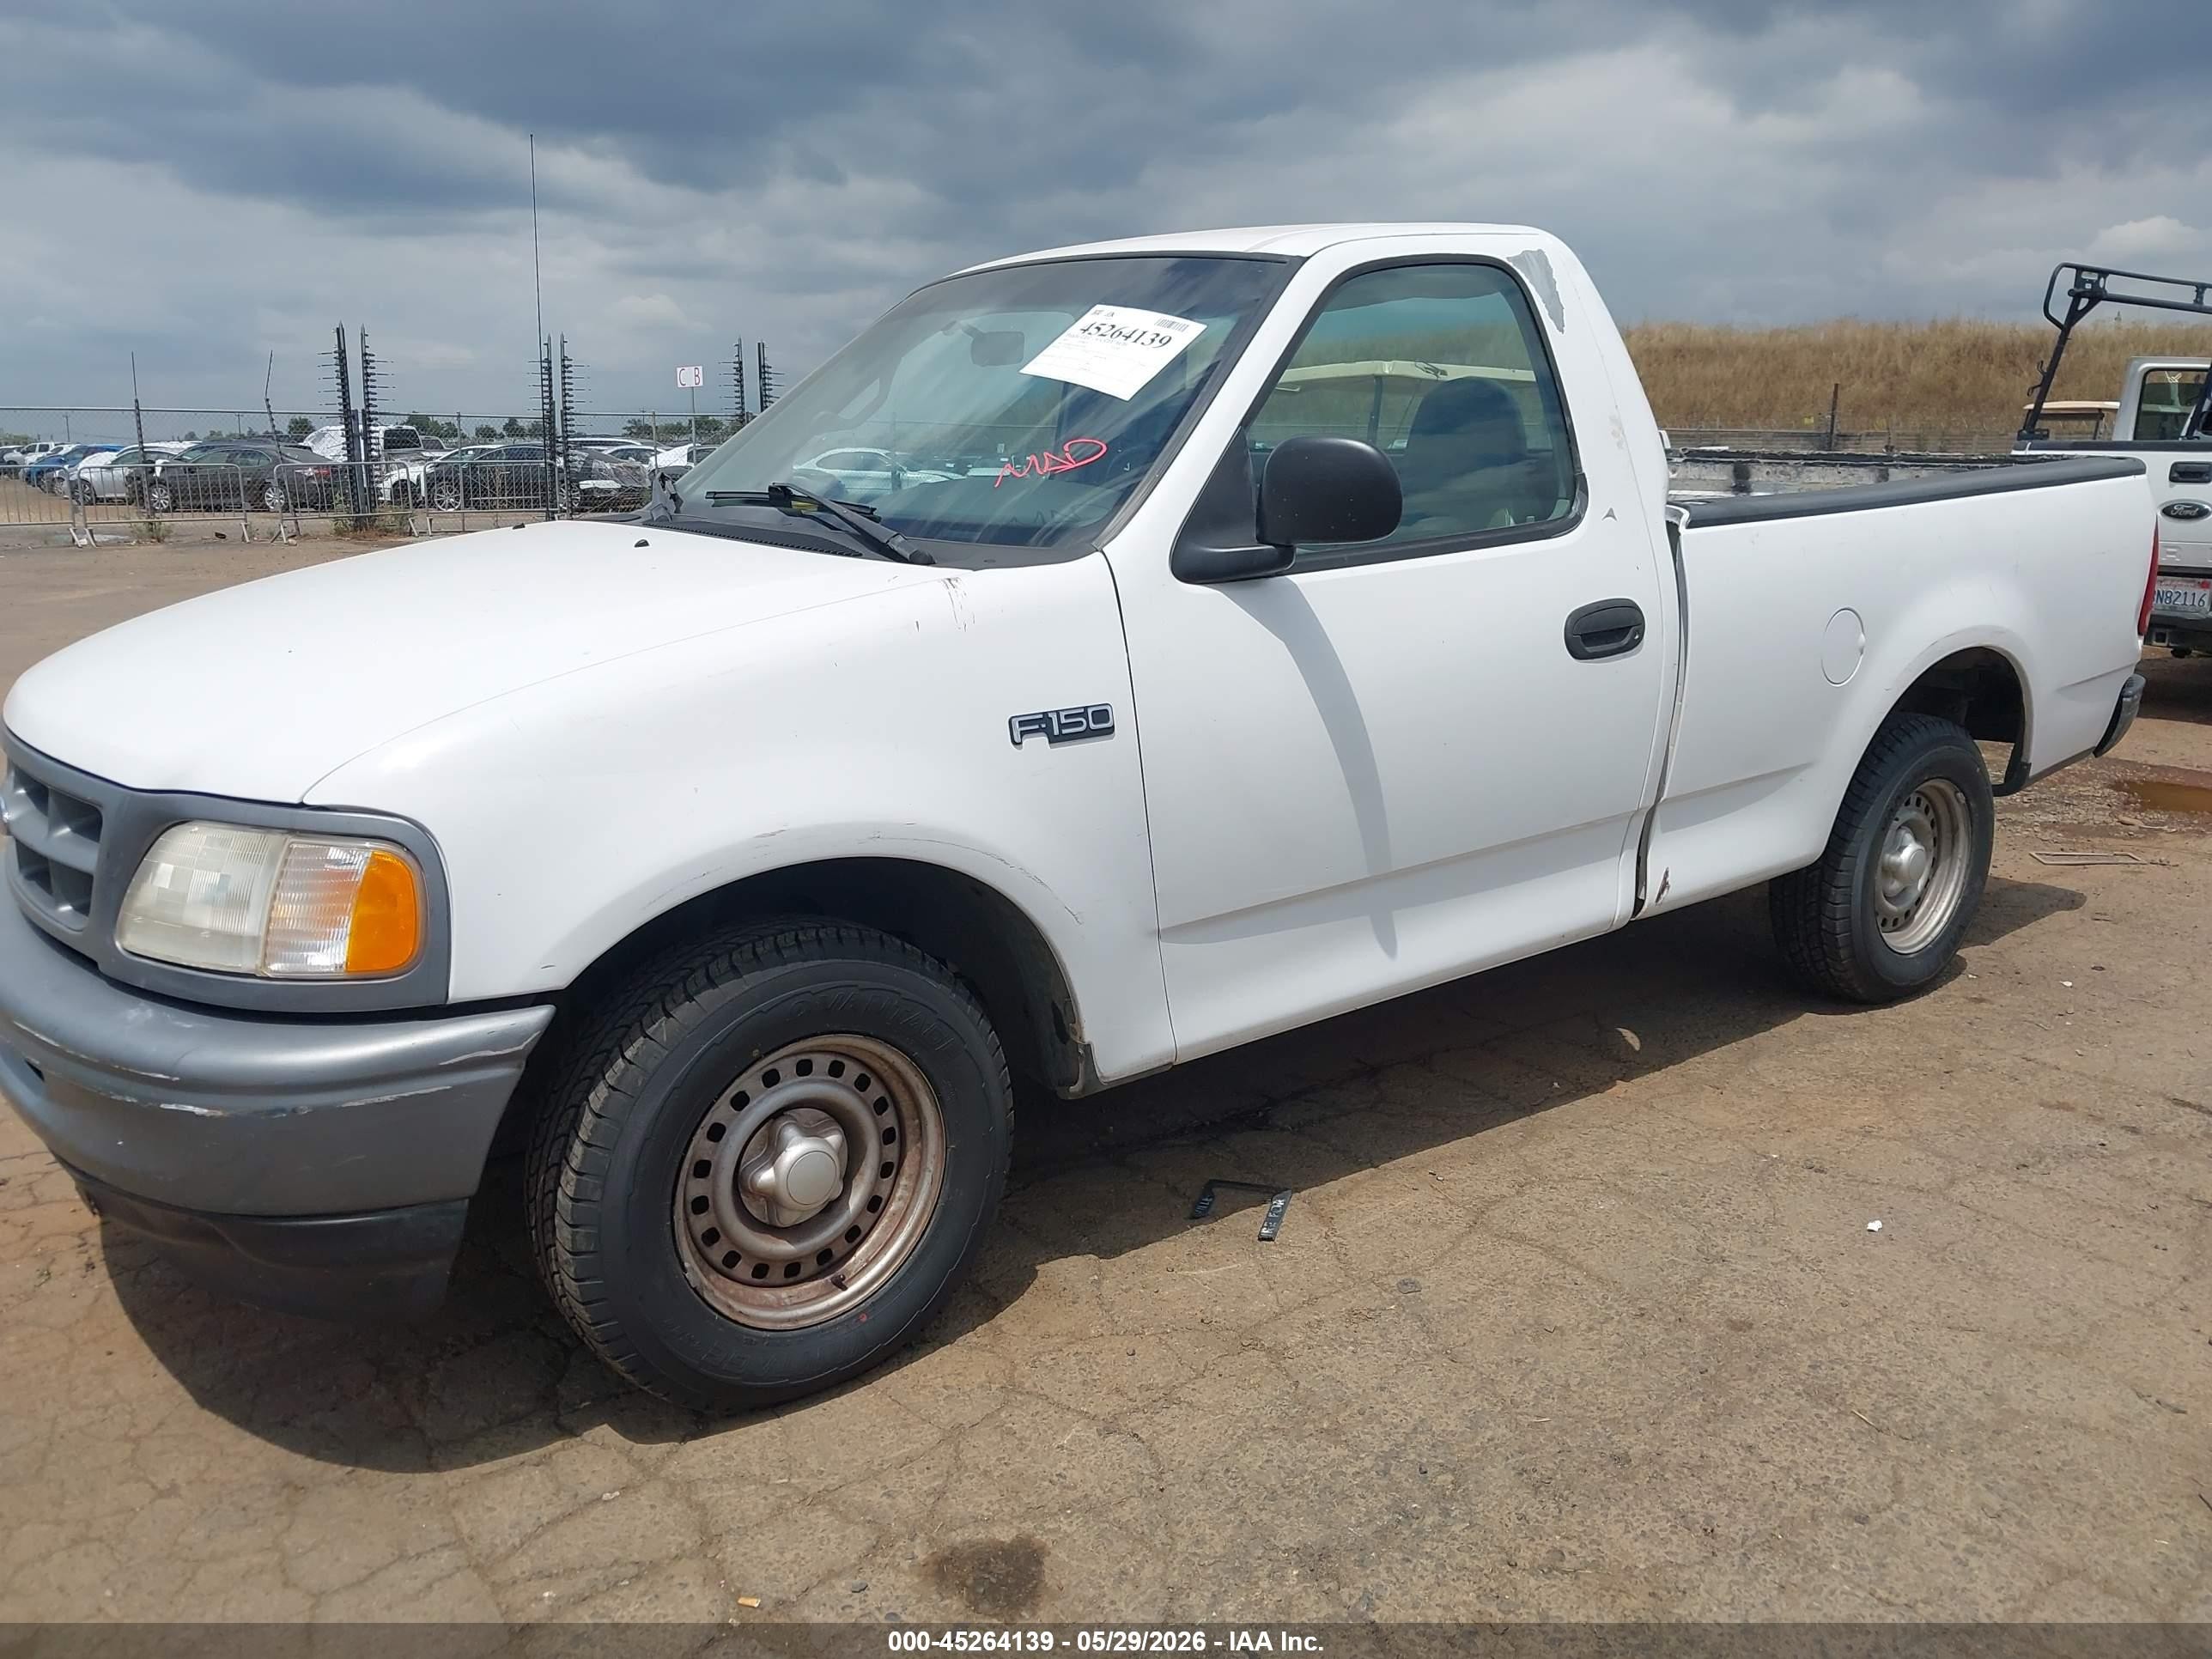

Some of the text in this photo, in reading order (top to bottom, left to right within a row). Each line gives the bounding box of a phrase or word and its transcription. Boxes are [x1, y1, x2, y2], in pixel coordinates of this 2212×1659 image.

[1080, 321, 1173, 348] 45264139
[679, 367, 701, 386] C B
[2170, 504, 2200, 516] Ford
[2154, 589, 2208, 607] N82116
[1010, 703, 1115, 744] F-150
